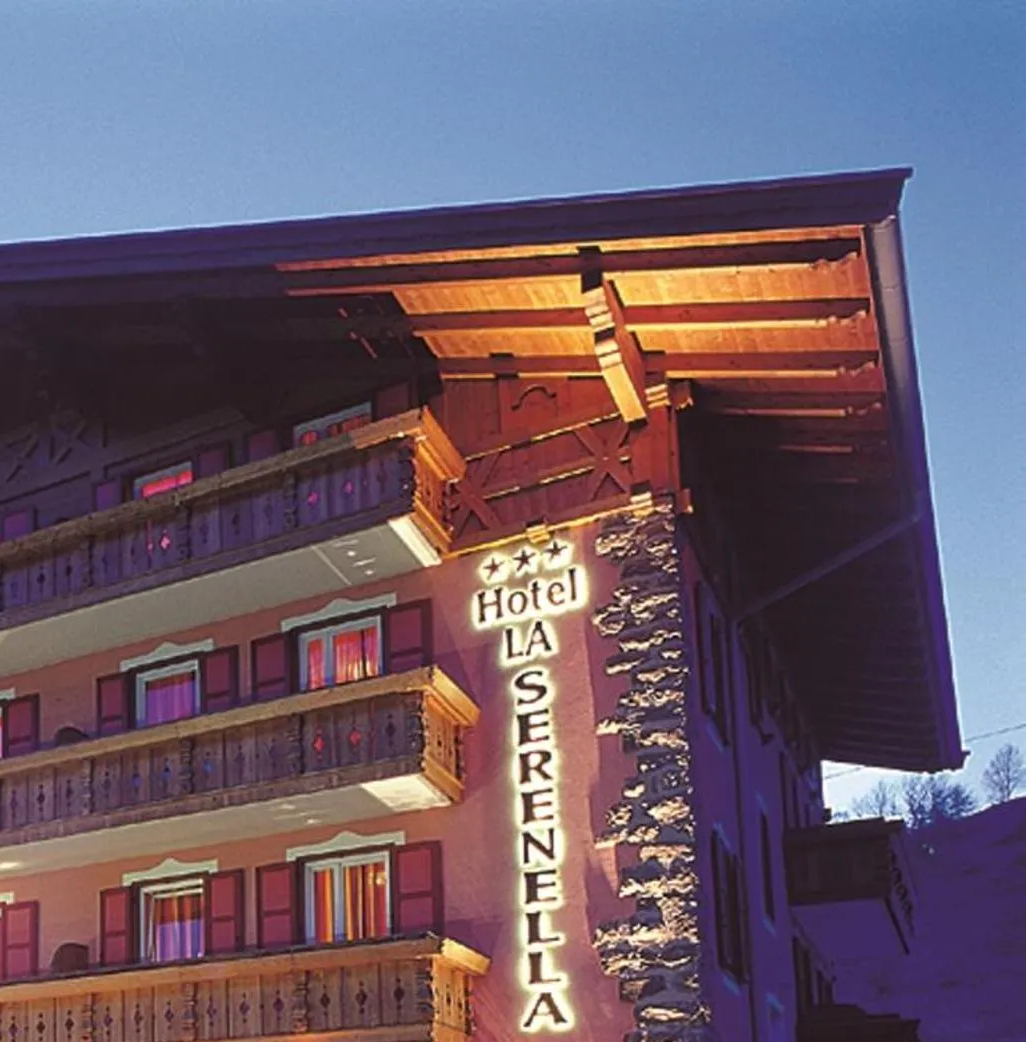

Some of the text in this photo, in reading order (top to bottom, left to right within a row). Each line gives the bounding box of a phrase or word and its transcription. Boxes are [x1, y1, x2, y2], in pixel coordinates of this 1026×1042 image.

[477, 567, 577, 623] Hotel
[505, 620, 553, 659] LA
[514, 670, 568, 1028] SERENELLA
